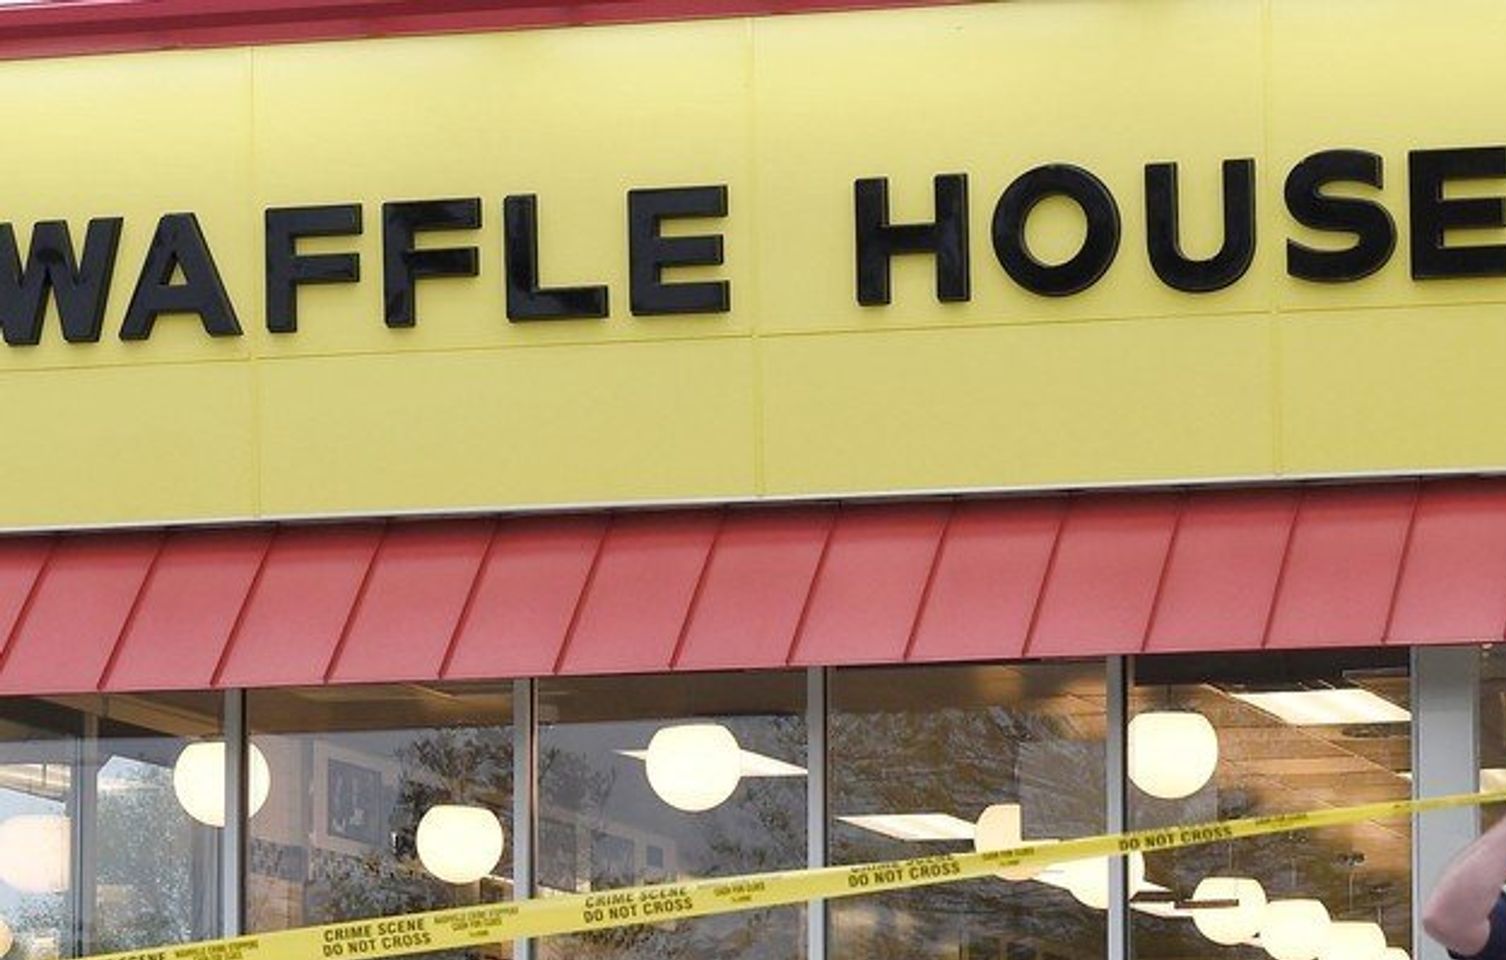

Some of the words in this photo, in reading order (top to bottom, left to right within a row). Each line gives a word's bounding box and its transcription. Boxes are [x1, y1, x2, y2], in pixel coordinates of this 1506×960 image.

[0, 184, 731, 346] WAFFLE
[1119, 838, 1140, 850] DO
[1144, 833, 1174, 848] NOT
[1180, 826, 1233, 843] CROSS
[848, 874, 869, 888] DO
[874, 869, 903, 884] NOT
[910, 861, 961, 880] CROSS
[585, 893, 634, 908] CRIME
[640, 886, 689, 902] SCENE
[583, 909, 604, 924] DO
[608, 905, 637, 919] NOT
[643, 898, 693, 915] CROSS
[323, 924, 372, 942] CRIME
[378, 918, 425, 936] SCENE
[323, 943, 344, 957] DO
[348, 939, 376, 954] NOT
[382, 932, 431, 949] CROSS
